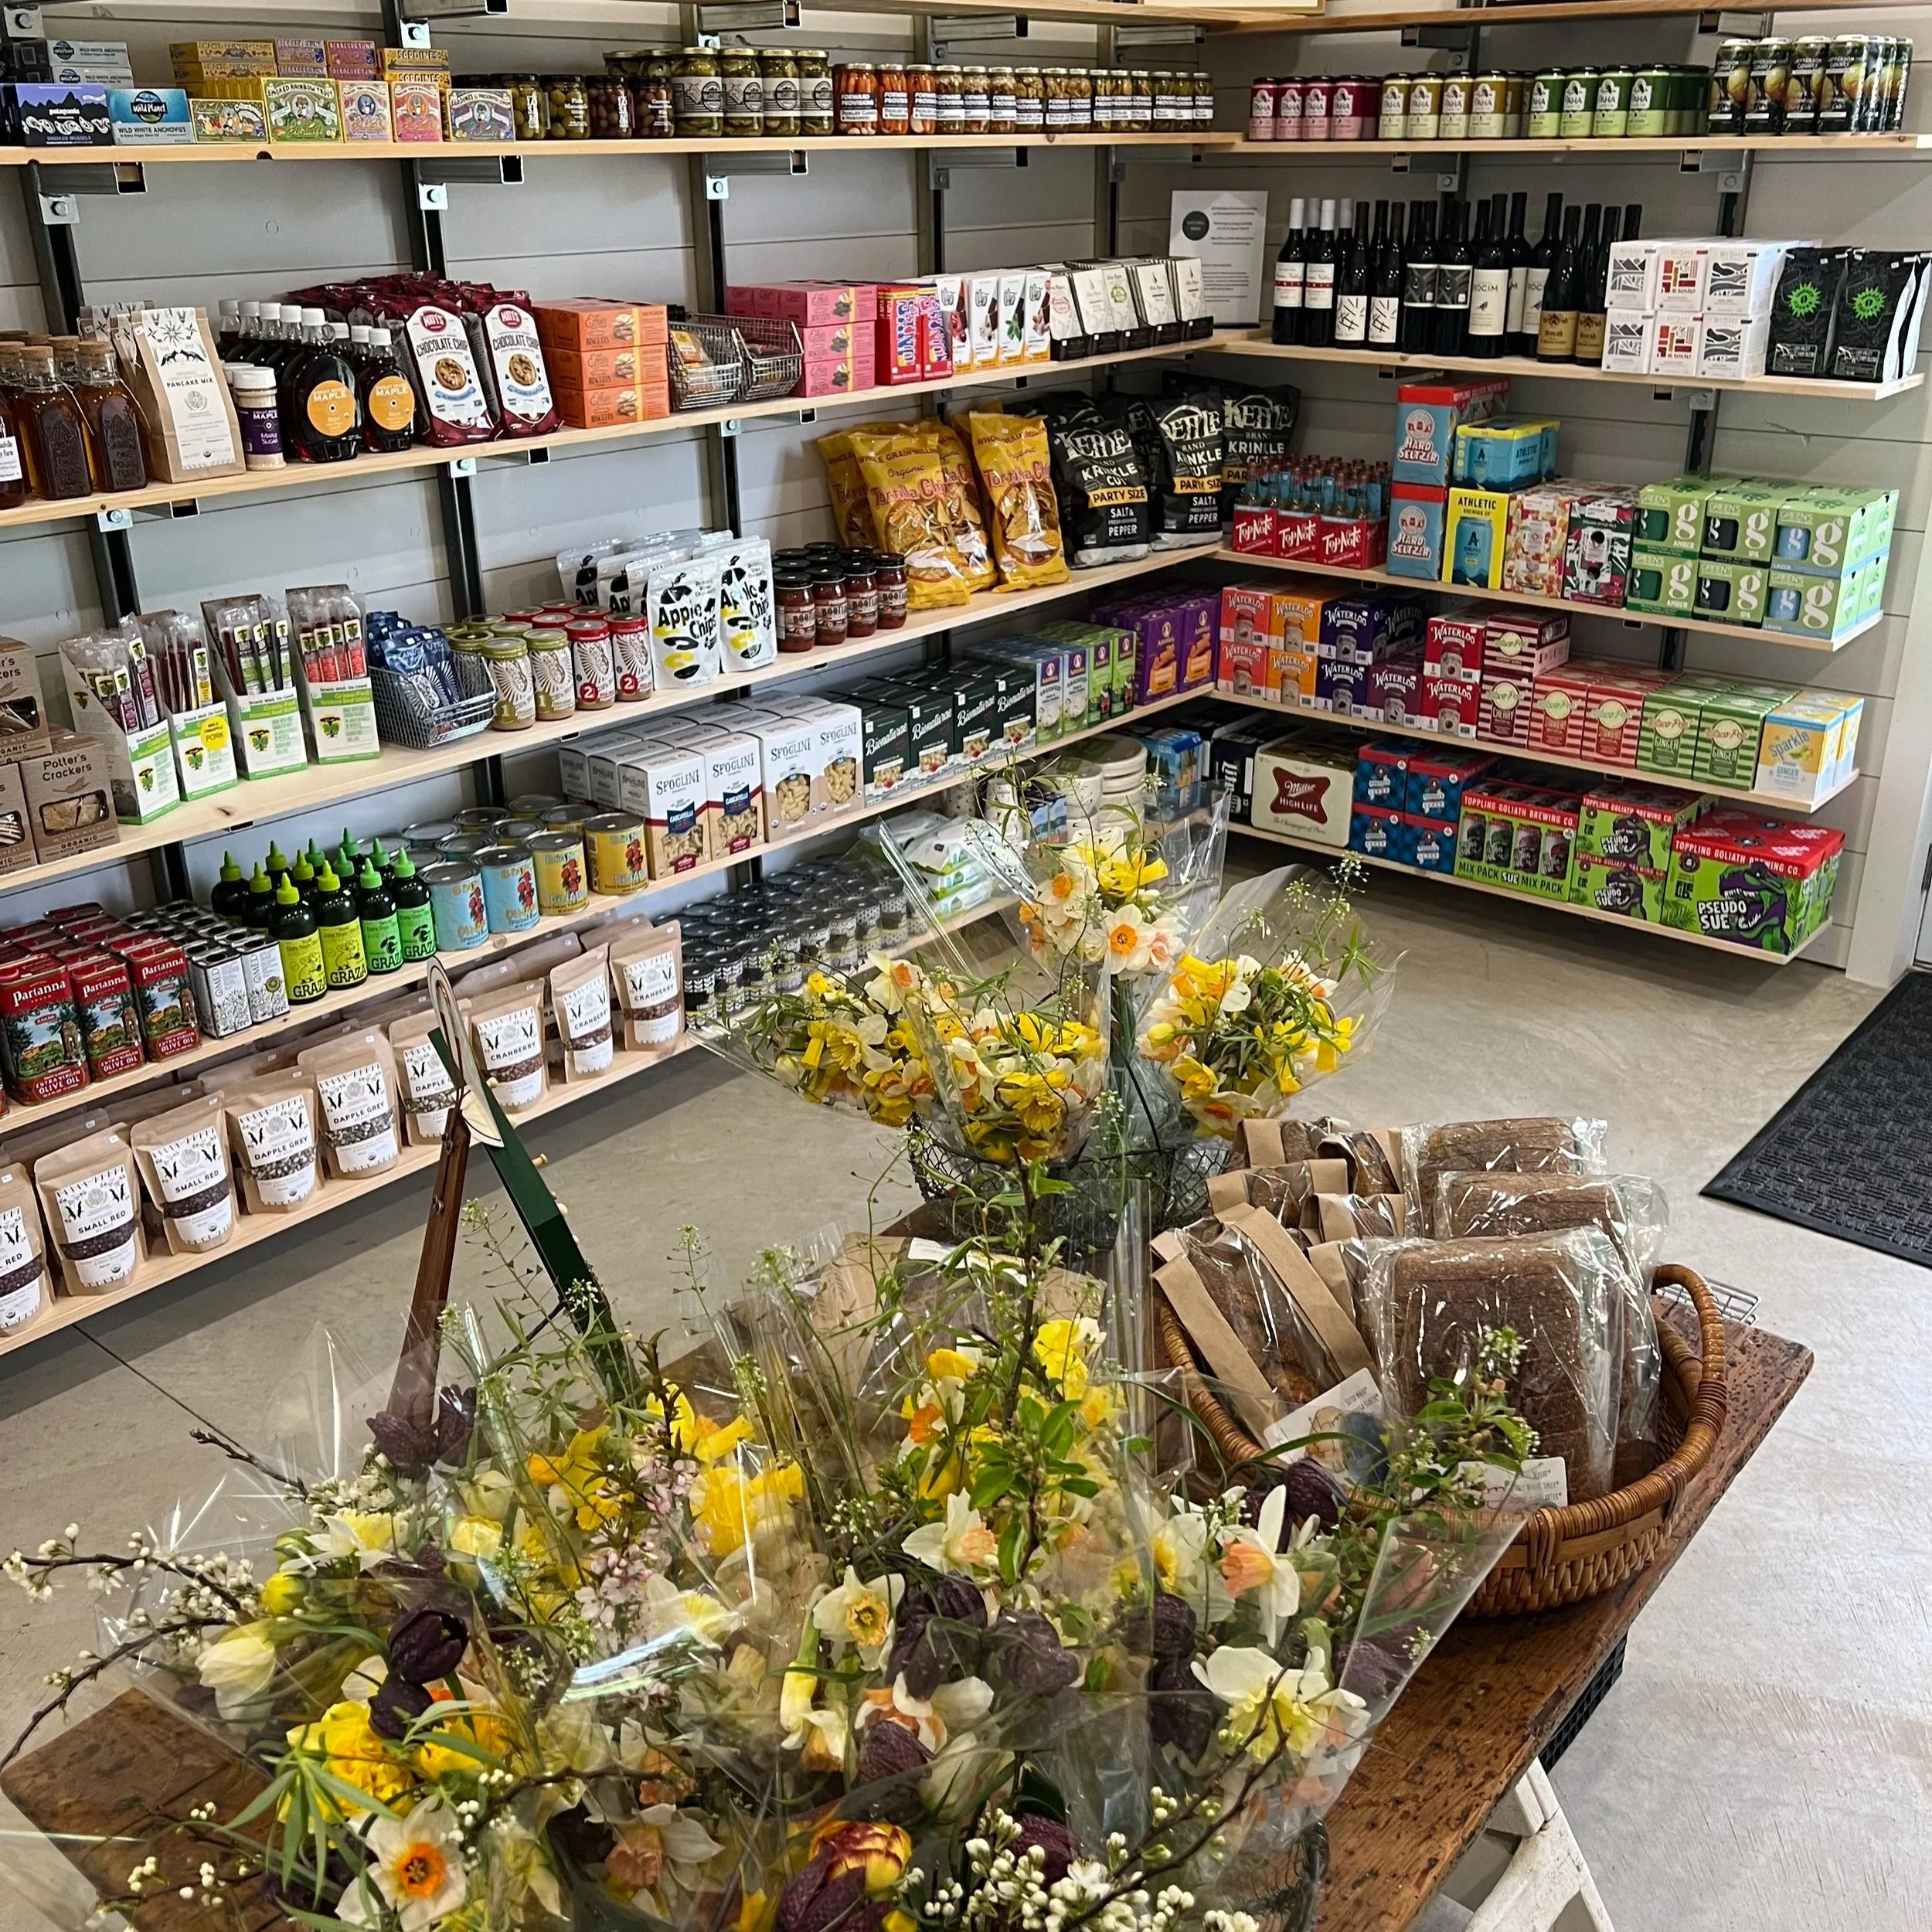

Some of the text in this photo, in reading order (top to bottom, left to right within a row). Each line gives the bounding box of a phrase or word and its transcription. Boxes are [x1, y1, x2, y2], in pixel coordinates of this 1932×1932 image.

[397, 49, 439, 60] SARDINES
[416, 337, 453, 358] CHOCOLATE
[492, 334, 526, 351] CHOCOLATE
[200, 377, 214, 386] MIX
[313, 392, 347, 403] MAPLE
[376, 386, 409, 396] MAPLE
[1406, 439, 1432, 452] HARD
[1515, 444, 1538, 460] ATHLETIC
[1397, 448, 1439, 464] SELTZER
[886, 464, 926, 478] Organic
[871, 482, 917, 505] Tortilla
[1093, 488, 1146, 504] PARTY SIZE
[1458, 495, 1498, 510] ATHLETIC
[1110, 507, 1128, 518] SALT
[1188, 512, 1219, 524] PEPPER
[1107, 524, 1138, 537] PEPPER
[1398, 533, 1425, 546] HARD
[1672, 539, 1695, 549] AMBER
[1391, 543, 1431, 558] SELTZER
[1748, 550, 1760, 559] IPA
[1227, 593, 1264, 611] WATERLOO
[1273, 600, 1314, 618] WATERLOO
[1666, 600, 1688, 609] AMBER
[658, 603, 702, 629] Apple
[1325, 607, 1367, 627] WATERLOO
[1430, 623, 1476, 645] WATERLOO
[1222, 644, 1261, 662] WATERLOO
[1271, 653, 1310, 671] WATERLOO
[1321, 661, 1364, 681] WATERLOO
[624, 677, 634, 690] 2
[1372, 670, 1416, 690] WATERLOO
[583, 685, 594, 699] 2
[996, 682, 1036, 713] Bionaturae
[1427, 679, 1472, 701] WATERLOO
[956, 695, 996, 728] Bionaturae
[911, 708, 953, 742] Bionaturae
[206, 732, 224, 742] PORK
[819, 722, 857, 746] SFOGLINI
[866, 721, 908, 757] Bionaturae
[770, 737, 811, 762] SFOGLINI
[1655, 737, 1679, 750] GINGER
[1767, 729, 1810, 761] Sparkle
[43, 753, 87, 770] Potter's
[1712, 747, 1737, 761] GINGER
[42, 763, 93, 782] Crackers
[712, 751, 755, 778] SFOGLINI
[656, 768, 700, 797] SFOGLINI
[1284, 780, 1317, 798] Miller
[1280, 796, 1319, 813] HIGH LIFE
[1464, 797, 1575, 827] TOPPLING GOLIATH BREWING CO.
[1583, 798, 1609, 811] TOPPLING
[1611, 803, 1634, 815] GOLIATH
[61, 835, 98, 849] ORGANIC
[1600, 835, 1629, 845] PSEUDO
[1601, 843, 1621, 854] SUE
[1575, 852, 1602, 865] TOPPLING
[1675, 839, 1801, 877] TOPPLING GOLIATH CO.
[1458, 862, 1564, 896] MIX PACK SUE MIX PACK
[1594, 888, 1622, 899] PSEUDO
[1596, 896, 1615, 906] SUE
[1697, 901, 1747, 916] PSEUDO
[1700, 913, 1731, 930] SUE
[141, 955, 185, 980] Partanna
[12, 978, 66, 1007] Partanna
[82, 974, 128, 999] Partanna
[634, 984, 675, 1002] CRANBERRY
[160, 1036, 194, 1053] OLIVE OIL
[490, 1042, 536, 1062] CRANBERRY
[103, 1056, 138, 1073] OLIVE OIL
[38, 1075, 80, 1095] OLIVE OIL
[415, 1079, 446, 1092] DAPPLE
[333, 1102, 385, 1124] DAPPLE GREY
[254, 1137, 308, 1161] DAPPLE GREY
[175, 1169, 219, 1194] SMALL RED
[78, 1209, 127, 1235] SMALL RED
[5, 1252, 23, 1267] RED
